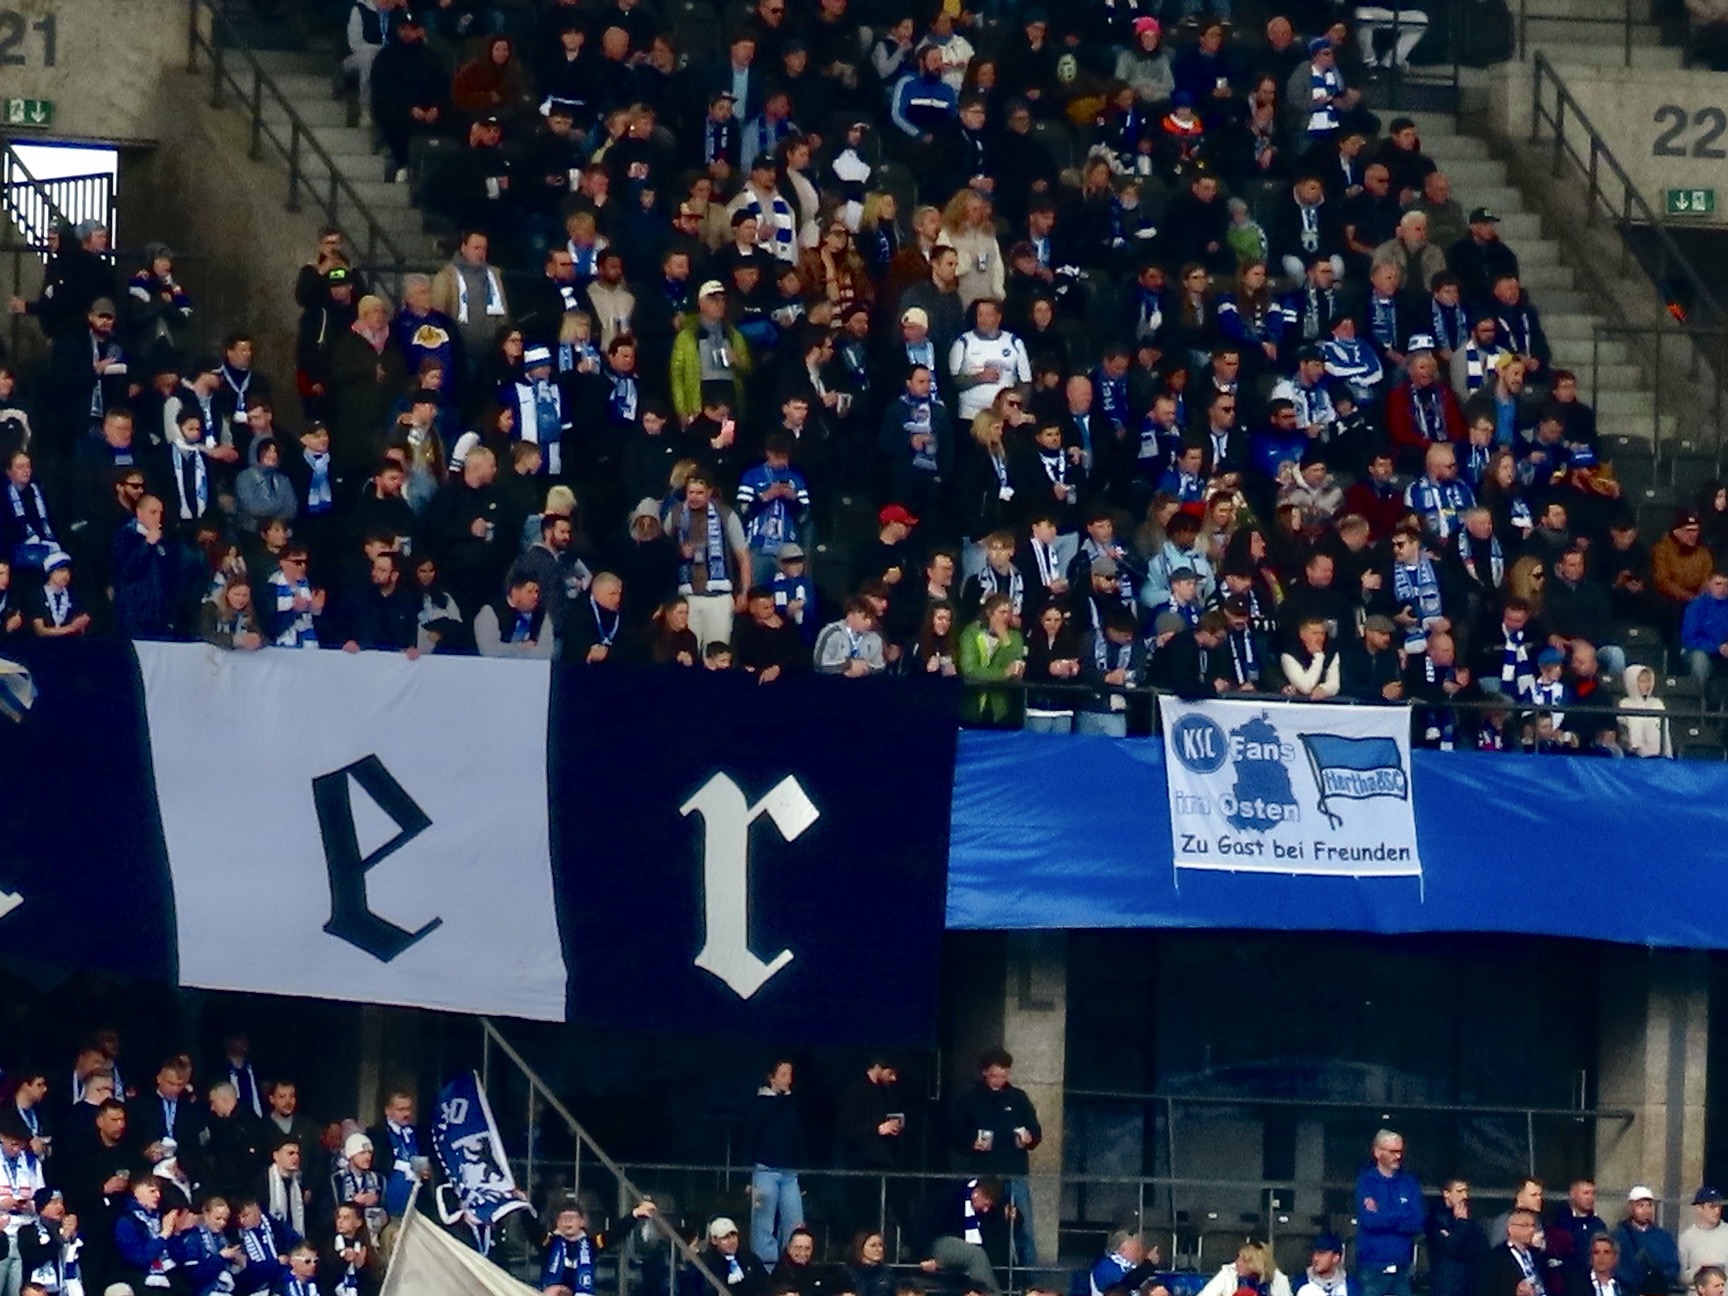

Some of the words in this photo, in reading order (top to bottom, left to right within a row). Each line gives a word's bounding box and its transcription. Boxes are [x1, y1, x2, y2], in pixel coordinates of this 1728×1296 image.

[1653, 104, 1728, 159] 22
[1182, 727, 1218, 760] KSC
[1229, 734, 1296, 762] Fans
[1175, 791, 1211, 815] im
[1221, 796, 1300, 822] Osten
[1181, 834, 1209, 854] Zu
[1218, 836, 1265, 856] Gast
[1273, 835, 1304, 859] bei
[1314, 841, 1411, 862] Freunden
